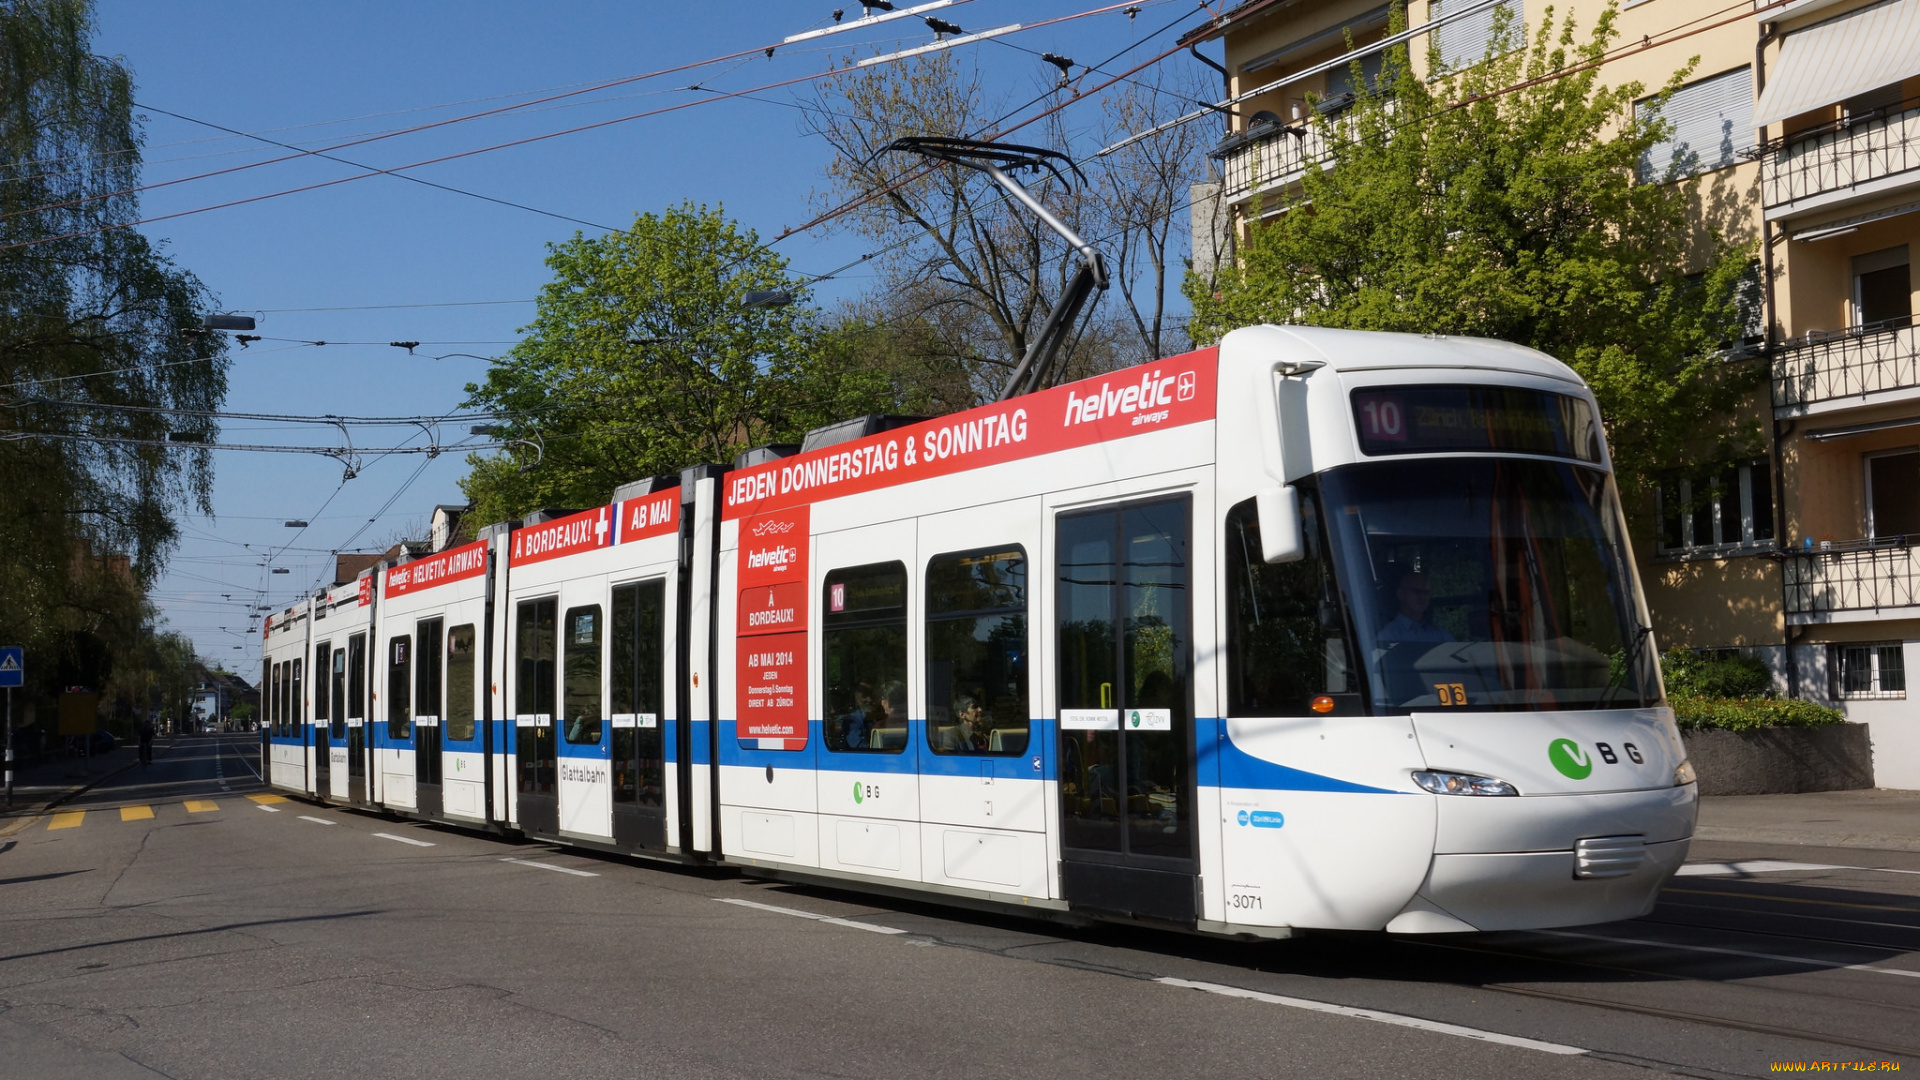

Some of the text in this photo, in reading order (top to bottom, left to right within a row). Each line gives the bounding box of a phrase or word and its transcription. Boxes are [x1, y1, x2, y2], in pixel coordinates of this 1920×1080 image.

[1063, 369, 1176, 427] helvetic
[1131, 410, 1169, 426] airways
[1363, 401, 1400, 435] 10
[728, 408, 1027, 506] JEDEN DONNERSTAG & SONNTAG
[631, 498, 672, 531] AB MAI
[515, 518, 592, 559] À BORDEAUX!
[412, 558, 446, 584] HELVETIC
[447, 546, 483, 576] AIRWAYS
[748, 545, 789, 569] helvetic
[833, 587, 844, 607] 10
[749, 608, 794, 626] BORDEAUX!
[748, 651, 793, 667] AB MAI 2014
[763, 671, 778, 680] JEDEN
[748, 699, 764, 707] DIREKT
[767, 699, 774, 707] AB
[1437, 686, 1464, 704] 06
[748, 724, 794, 735] www.helvetic.com
[562, 764, 606, 784] Glattalbahn
[1233, 894, 1262, 909] 3071
